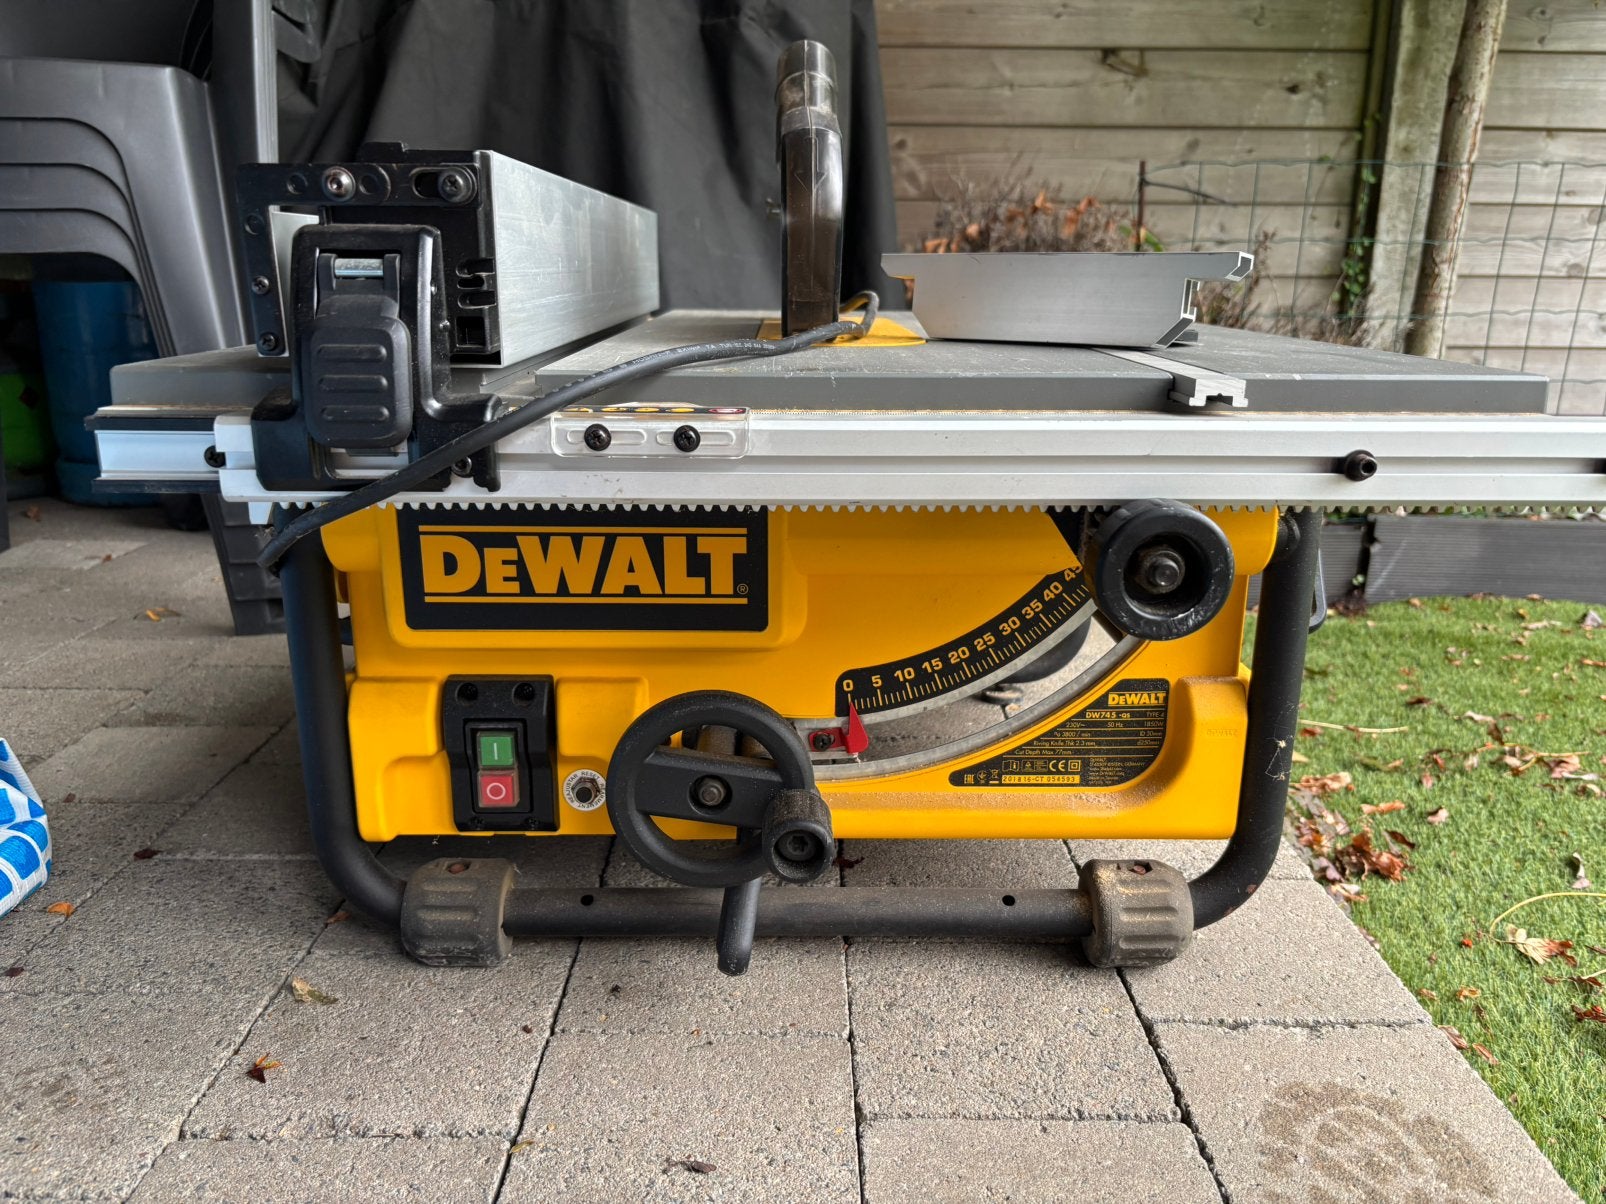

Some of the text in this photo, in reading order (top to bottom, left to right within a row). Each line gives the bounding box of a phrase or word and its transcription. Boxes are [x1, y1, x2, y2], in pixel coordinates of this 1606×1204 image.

[842, 679, 854, 692] 0
[871, 674, 883, 687] 5
[893, 667, 915, 682] 10
[921, 657, 943, 674] 15
[947, 646, 970, 664] 20
[973, 632, 996, 652] 25
[998, 616, 1021, 636] 30
[1021, 598, 1043, 620] 35
[1042, 581, 1064, 602] 40
[1085, 711, 1117, 719] DW745
[581, 770, 600, 780] RESET
